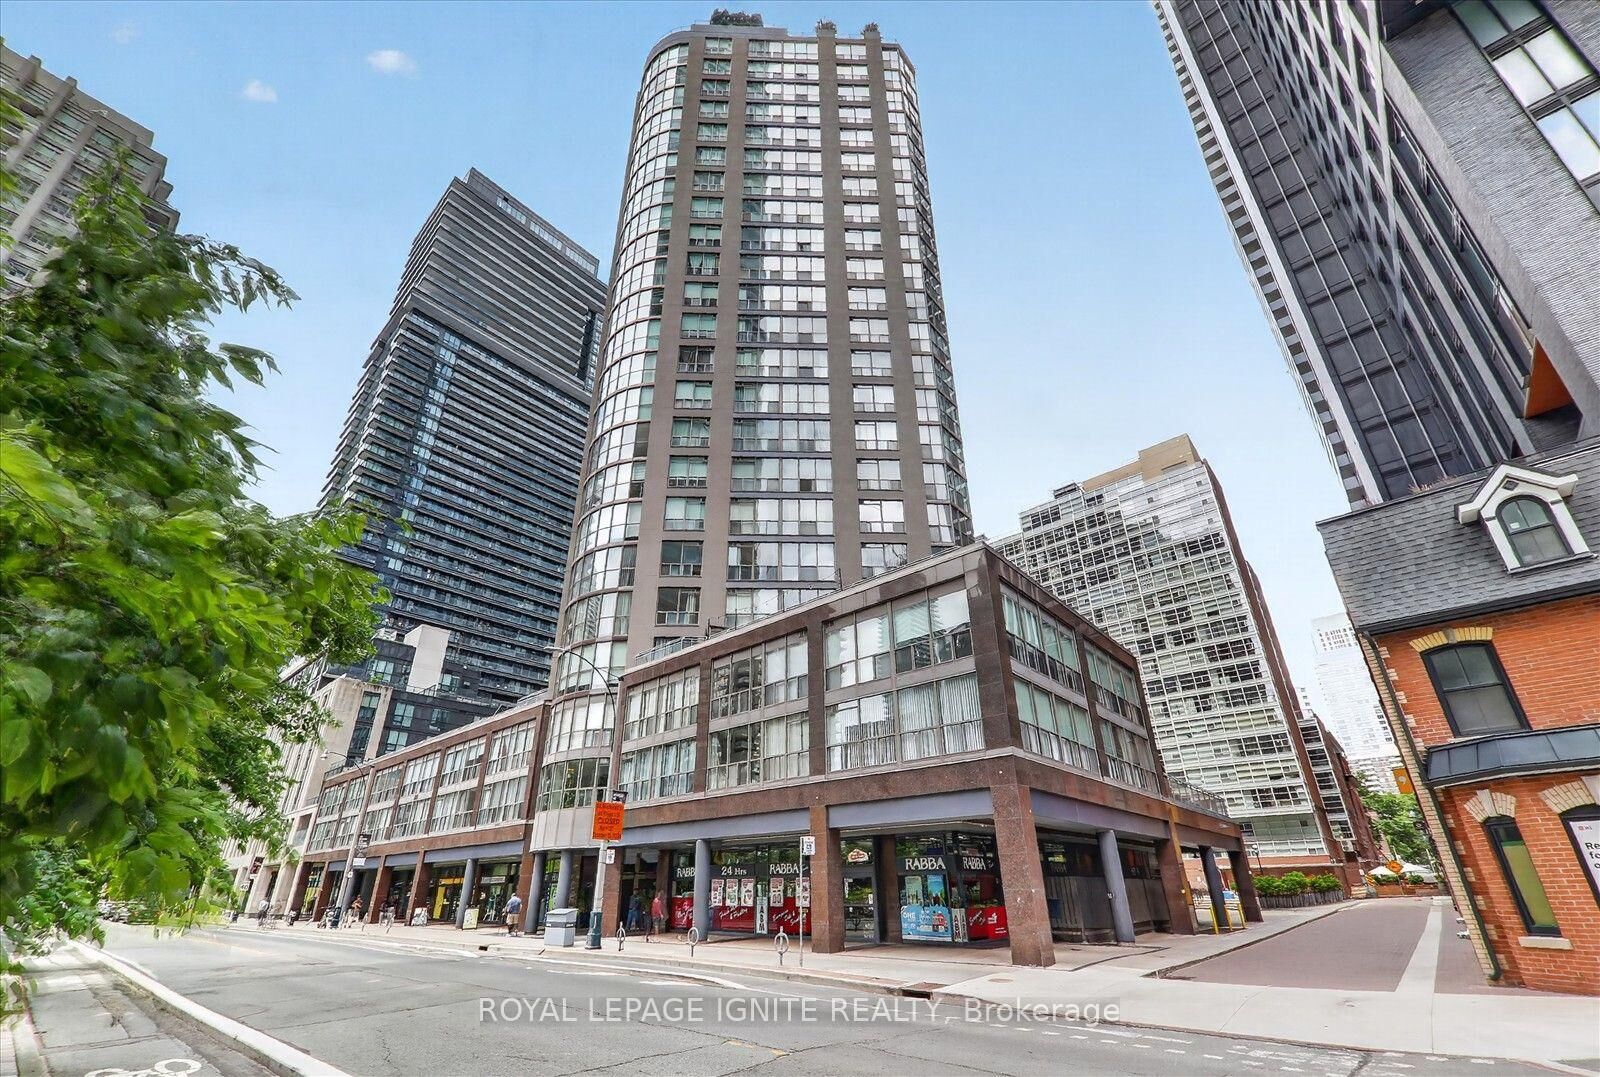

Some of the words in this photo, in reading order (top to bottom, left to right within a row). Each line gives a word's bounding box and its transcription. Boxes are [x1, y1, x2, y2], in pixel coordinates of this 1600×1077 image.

[769, 863, 800, 875] RABBA
[905, 857, 946, 871] RABBA
[962, 856, 987, 871] RABBA
[676, 867, 696, 878] RABB
[721, 866, 732, 876] 24
[734, 867, 747, 876] Hrs
